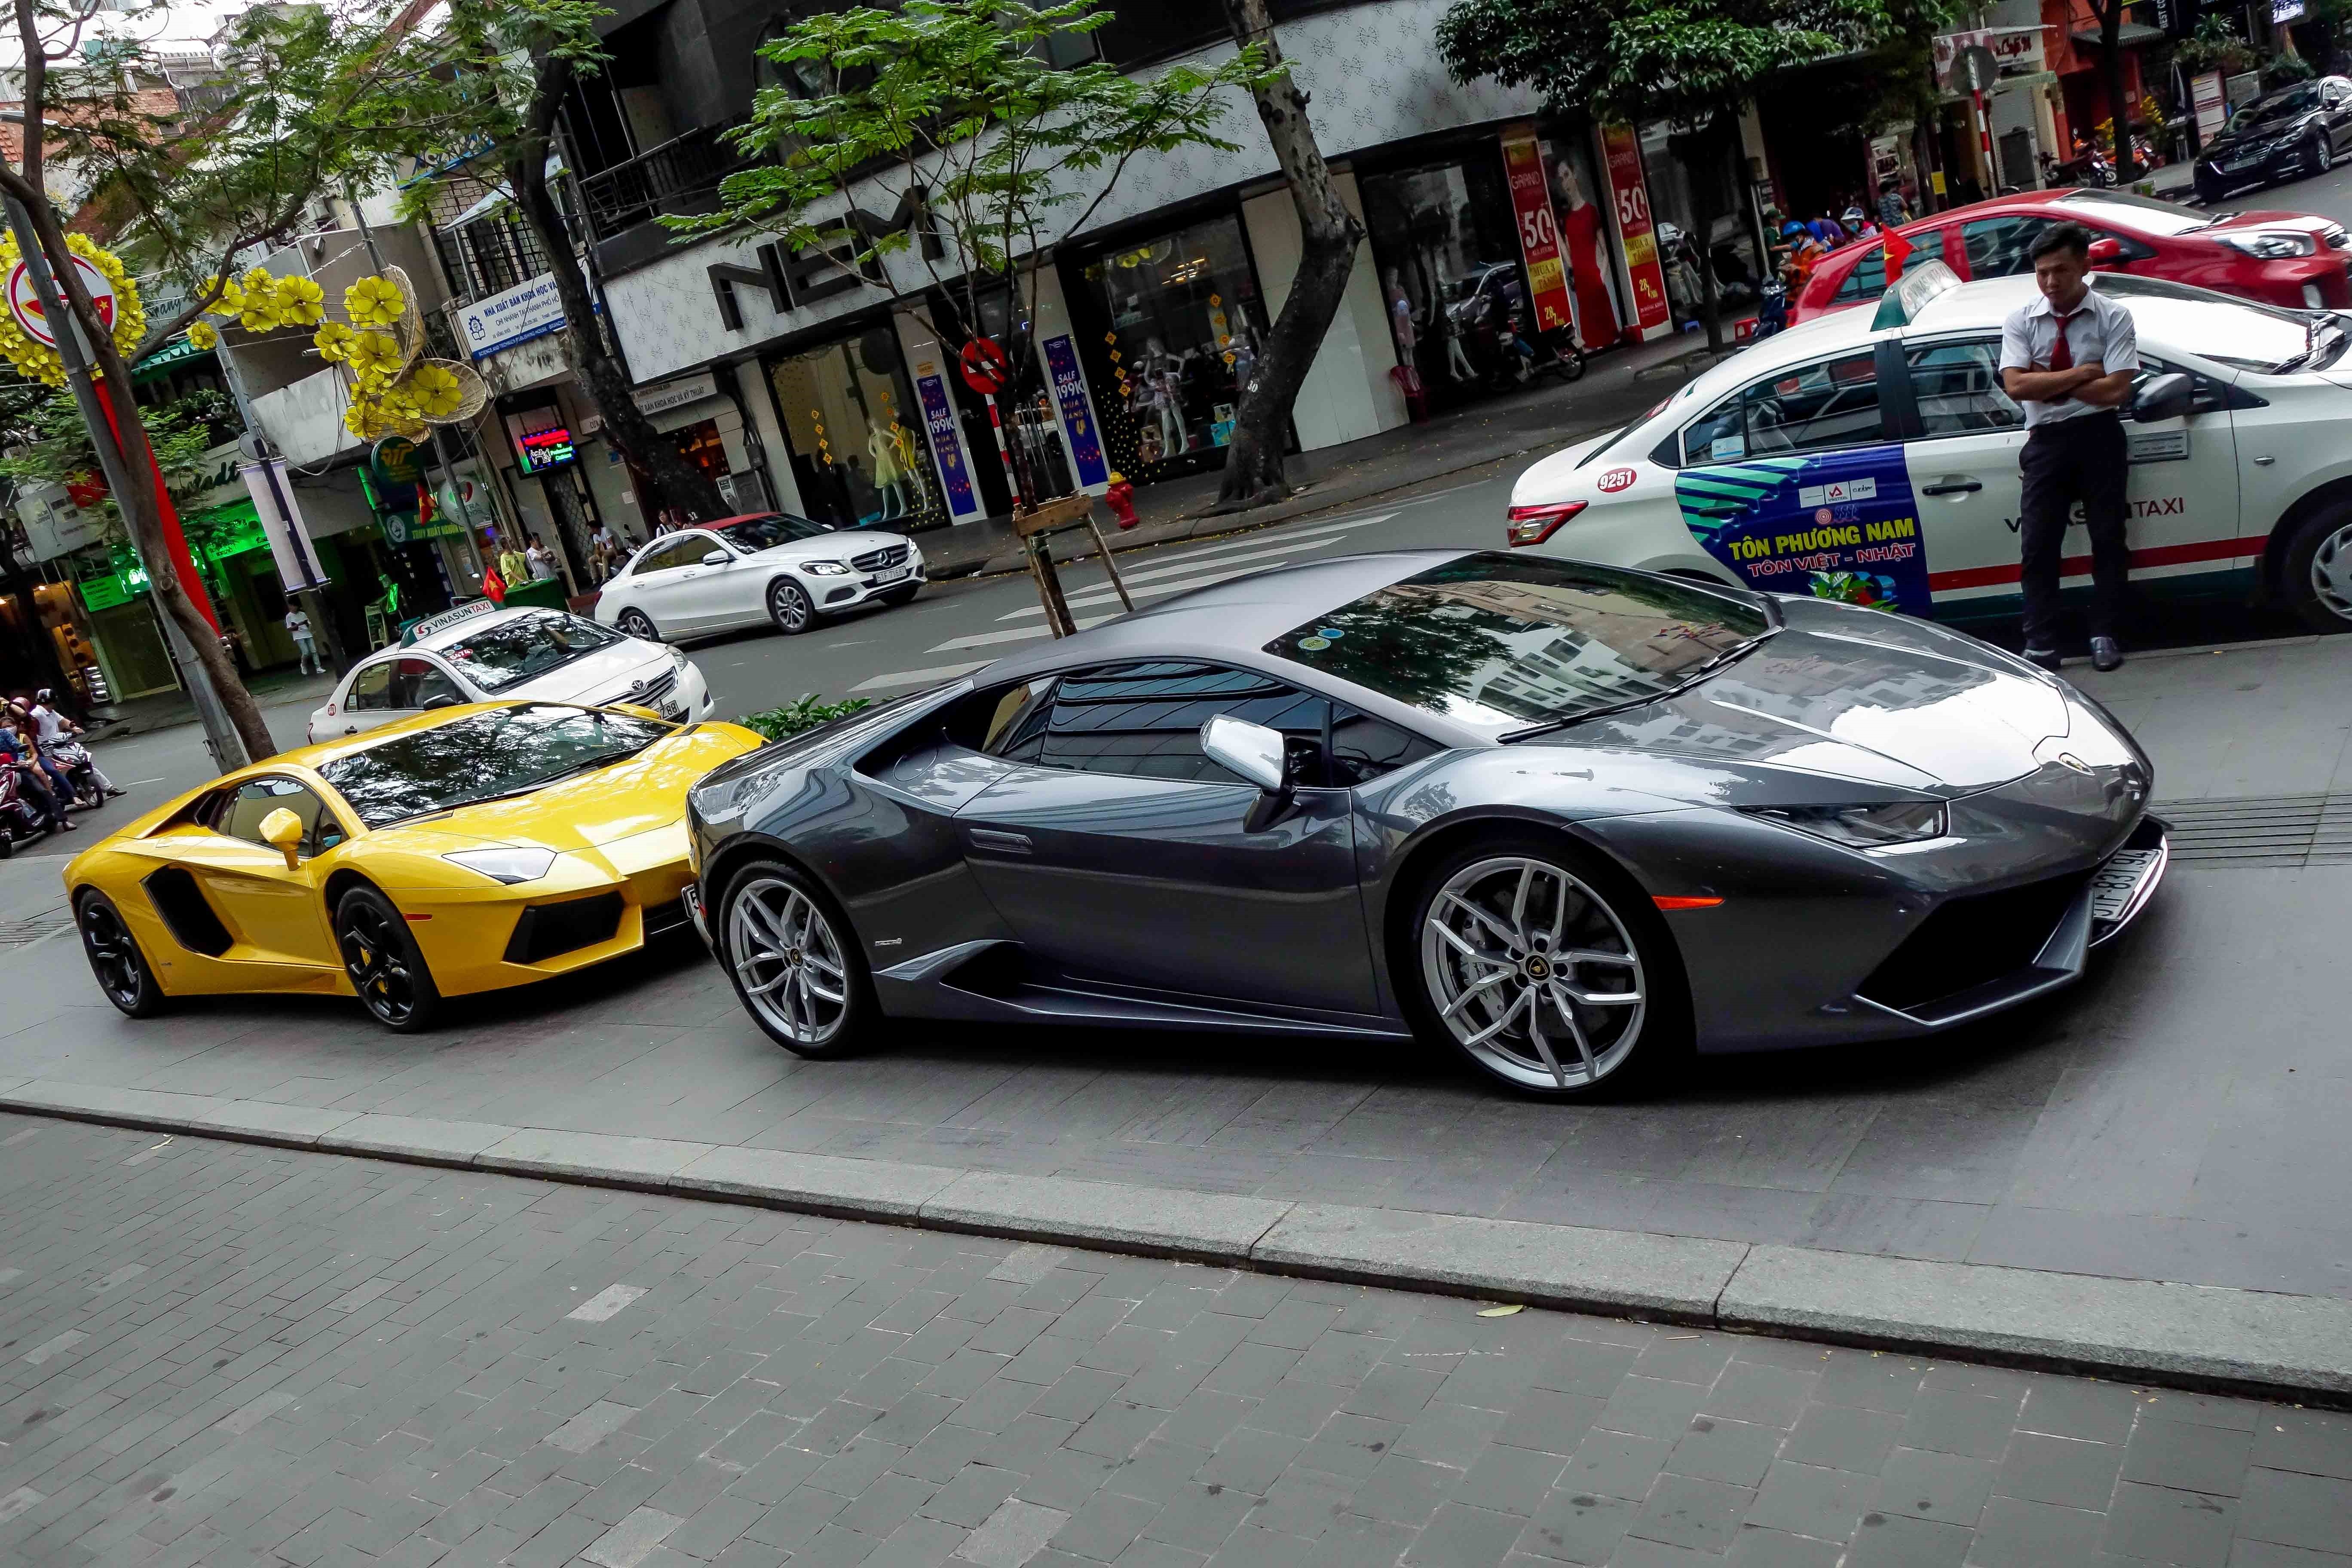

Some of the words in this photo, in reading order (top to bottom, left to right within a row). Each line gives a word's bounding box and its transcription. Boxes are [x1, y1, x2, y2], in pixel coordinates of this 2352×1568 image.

[1511, 172, 1540, 189] GRAND
[707, 185, 945, 332] NEM
[521, 290, 536, 302] KHOA
[537, 285, 548, 296] HỌC
[1049, 340, 1066, 349] NEM
[1058, 371, 1075, 383] SALE
[1056, 380, 1086, 399] 199K
[931, 408, 946, 420] SALE
[929, 416, 956, 434] 199K
[1599, 471, 1633, 491] 9251
[1729, 536, 1770, 560] TÔN
[1776, 526, 1862, 554] PHƯƠNG
[1865, 518, 1915, 542] NAM
[1748, 559, 1796, 577] TÔN
[1794, 552, 1841, 571] VIỆT
[1856, 542, 1916, 564] NHẬT
